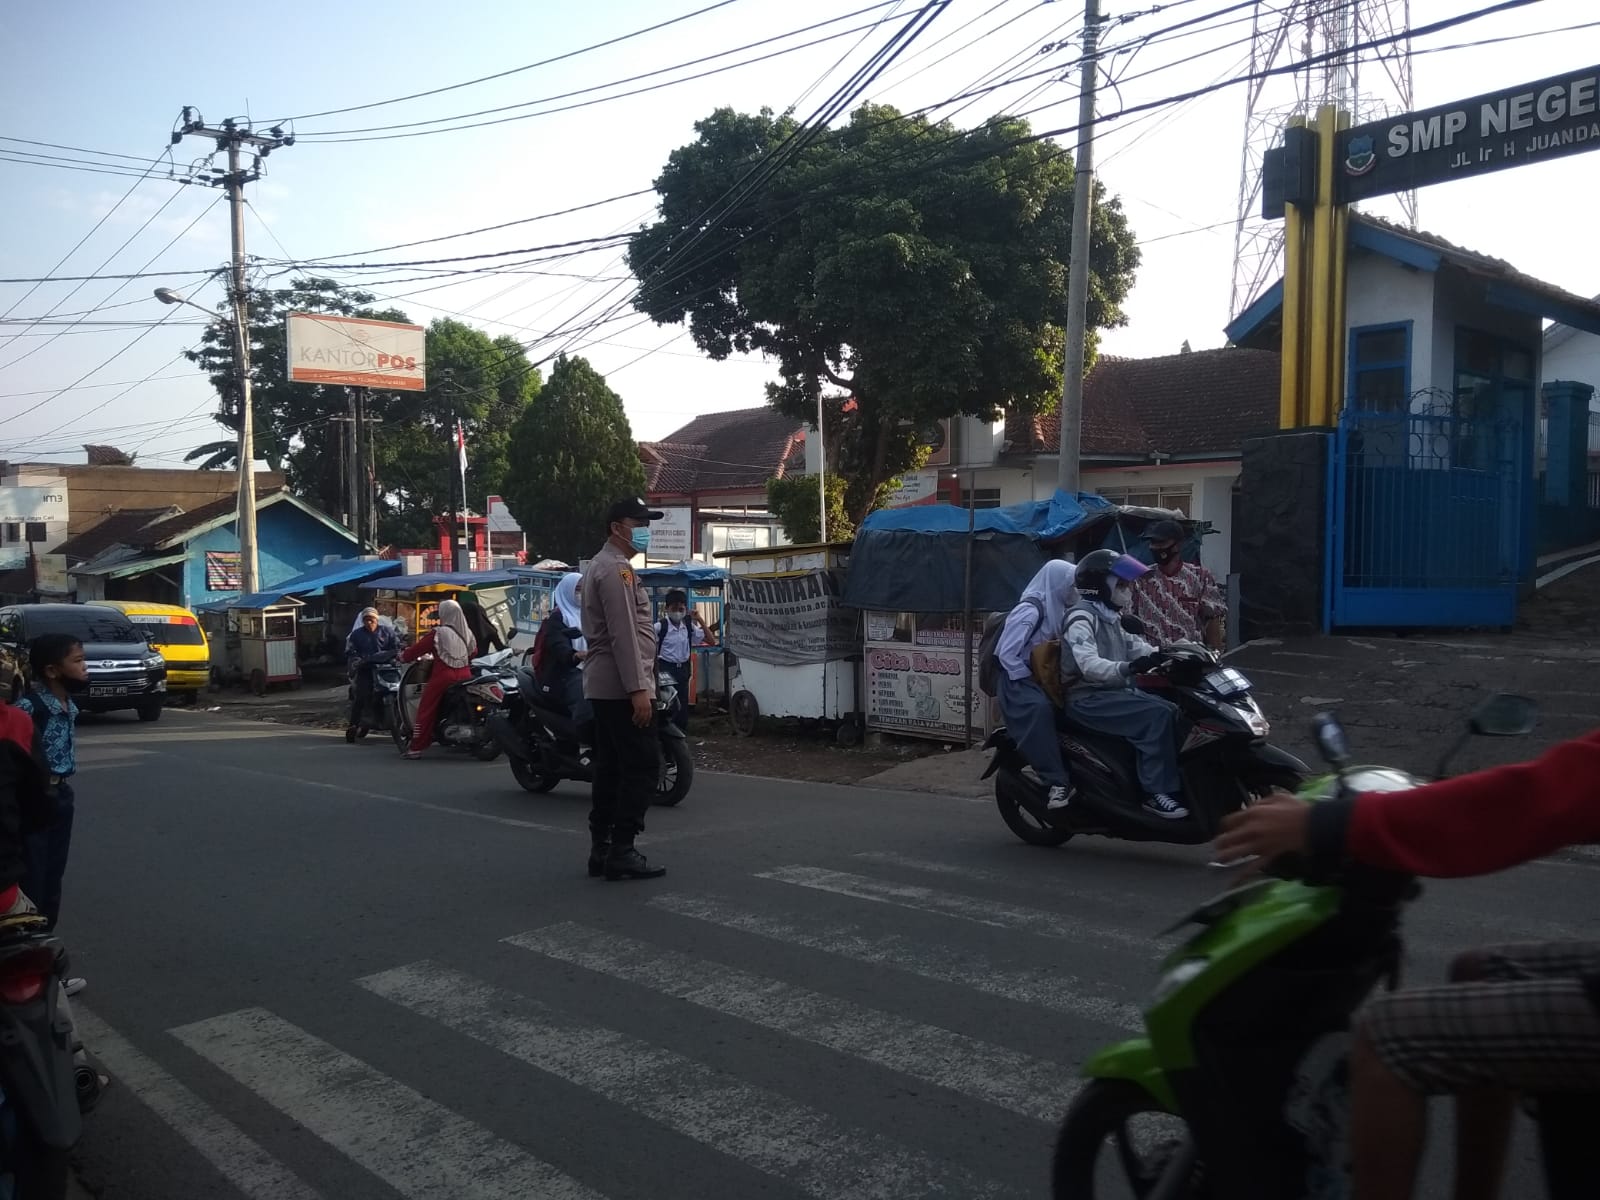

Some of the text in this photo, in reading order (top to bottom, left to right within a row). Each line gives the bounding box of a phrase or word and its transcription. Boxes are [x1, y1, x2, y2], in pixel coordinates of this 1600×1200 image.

[1387, 75, 1600, 159] SMP NEGE
[1451, 122, 1600, 169] JL Ir H JUANDA
[729, 571, 840, 604] NERIMAAN
[871, 650, 960, 675] Cita Rasa
